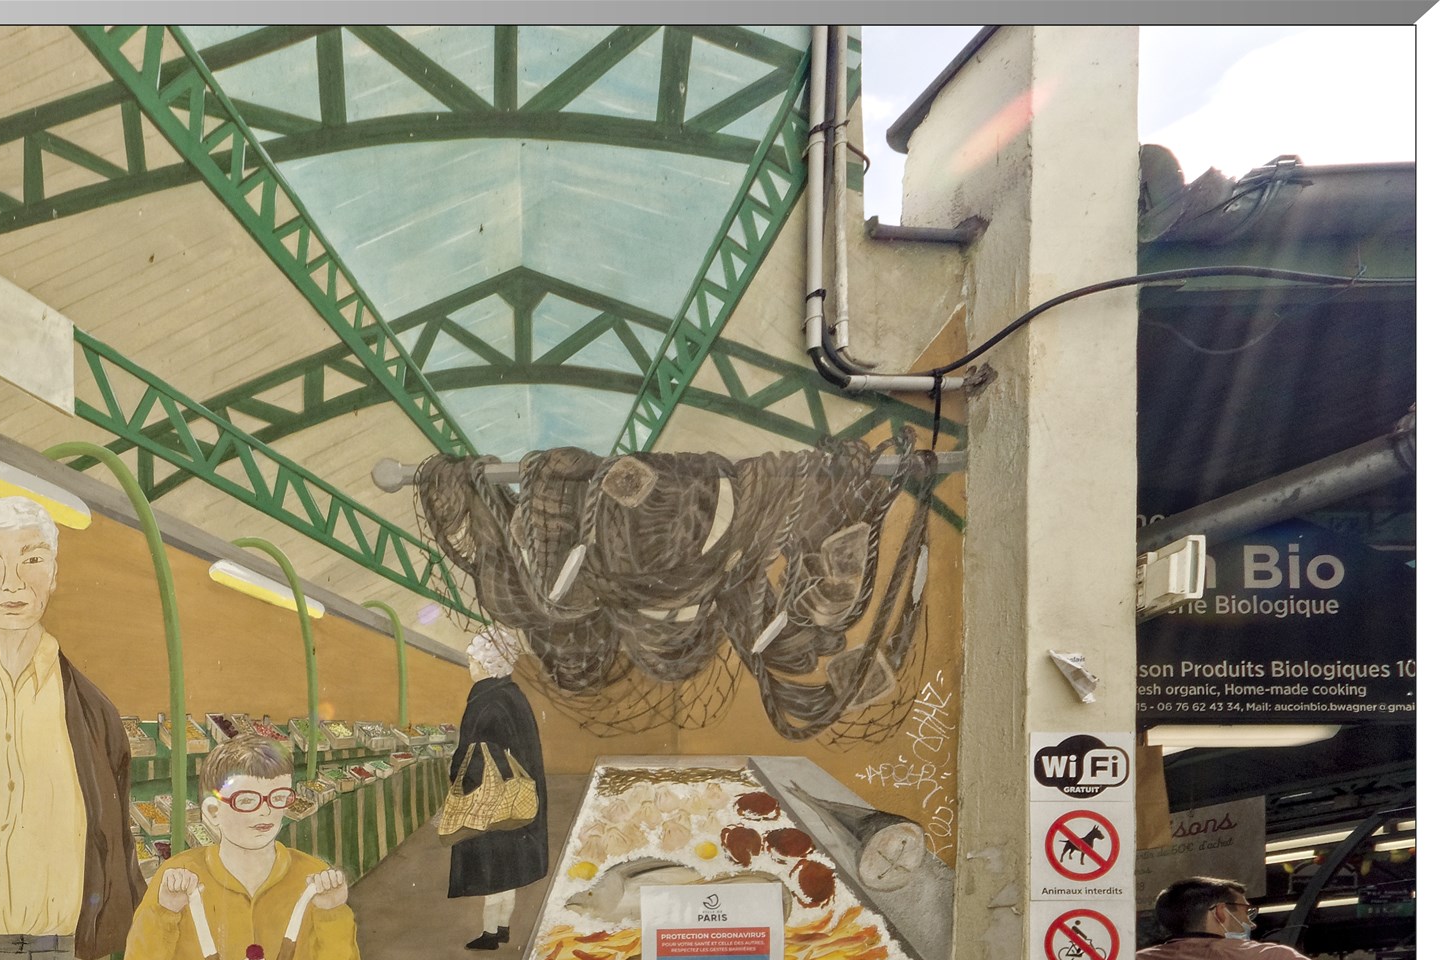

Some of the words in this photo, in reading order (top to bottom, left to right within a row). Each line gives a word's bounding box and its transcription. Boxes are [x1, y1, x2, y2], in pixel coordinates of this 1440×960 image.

[1243, 543, 1345, 590] Bio
[1215, 595, 1340, 618] Biologique
[1136, 664, 1174, 678] son
[1181, 661, 1265, 678] Produits
[1271, 660, 1390, 681] Biologiques
[1137, 684, 1161, 695] esh
[1165, 684, 1221, 698] organic,
[1224, 684, 1309, 696] Home-made
[1312, 683, 1367, 698] cooking
[1157, 702, 1173, 712] 06
[1176, 702, 1189, 711] 76
[1192, 702, 1206, 712] 62
[1209, 702, 1224, 712] 43
[1246, 702, 1272, 712] Mail:
[1063, 786, 1100, 795] GRATUIT
[1041, 886, 1083, 896] Animaux
[1084, 886, 1123, 896] interdits
[697, 914, 728, 922] PARIS
